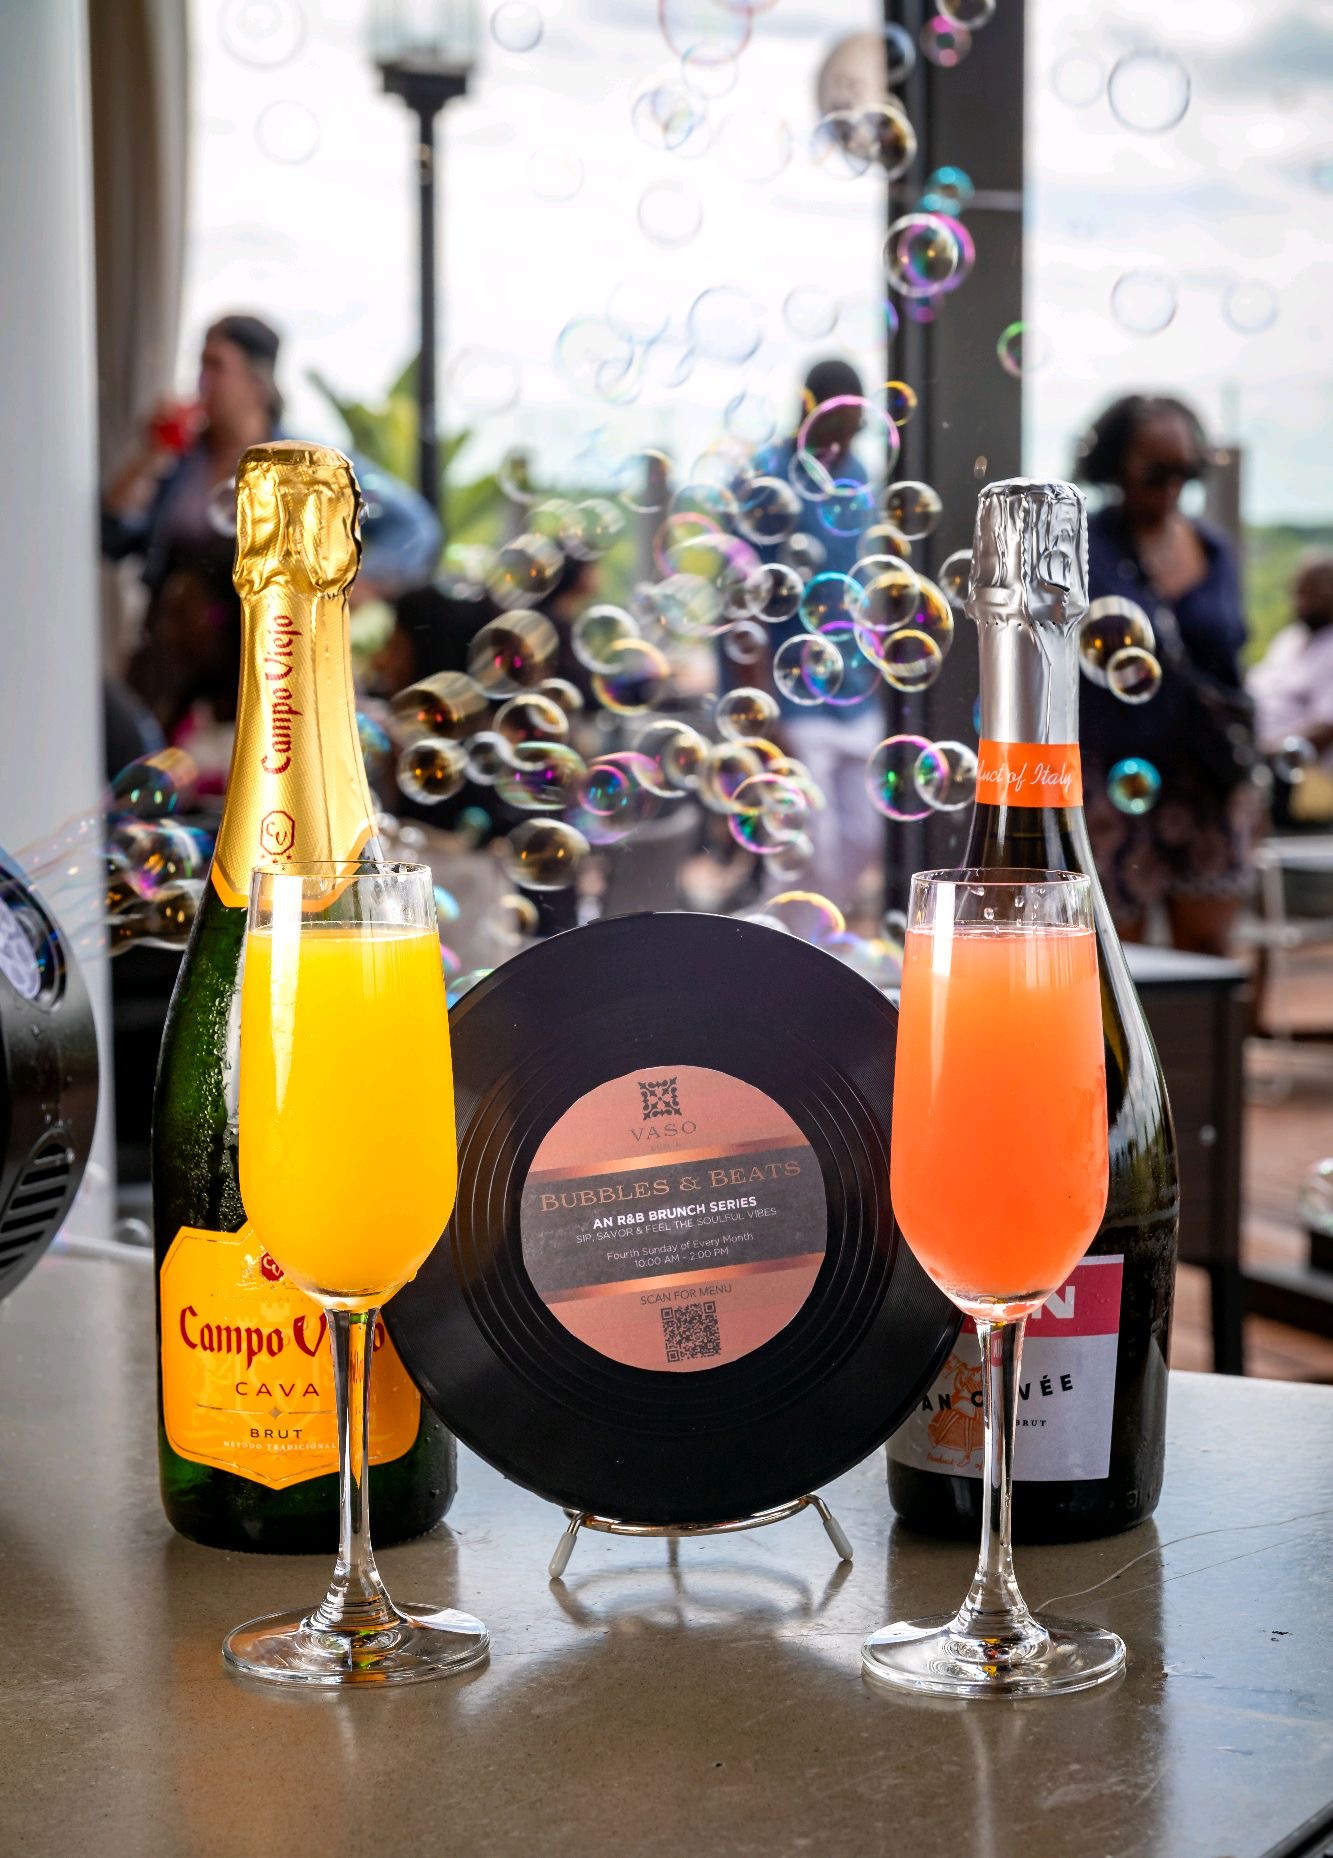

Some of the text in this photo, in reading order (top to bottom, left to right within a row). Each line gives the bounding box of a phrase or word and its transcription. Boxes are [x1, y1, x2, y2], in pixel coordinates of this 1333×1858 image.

[261, 614, 303, 775] Campo Viejo
[1007, 763, 1027, 792] of
[1030, 762, 1073, 793] Italy
[630, 1120, 697, 1141] VASO
[539, 1160, 801, 1211] BUBBLES & BEATS
[576, 1207, 777, 1244] SIP, SAVOR & FEEL THE SOULFUL VIBES
[592, 1196, 758, 1230] AN R&B BRUNCH SERIES
[607, 1232, 754, 1261] Fourth Sunday of Every Month
[664, 1253, 680, 1263] AM
[714, 1246, 729, 1257] PM
[640, 1283, 732, 1306] SCAN FOR MENU
[180, 1305, 284, 1371] Campo
[235, 1381, 320, 1397] CAVA
[250, 1428, 303, 1439] BRUT
